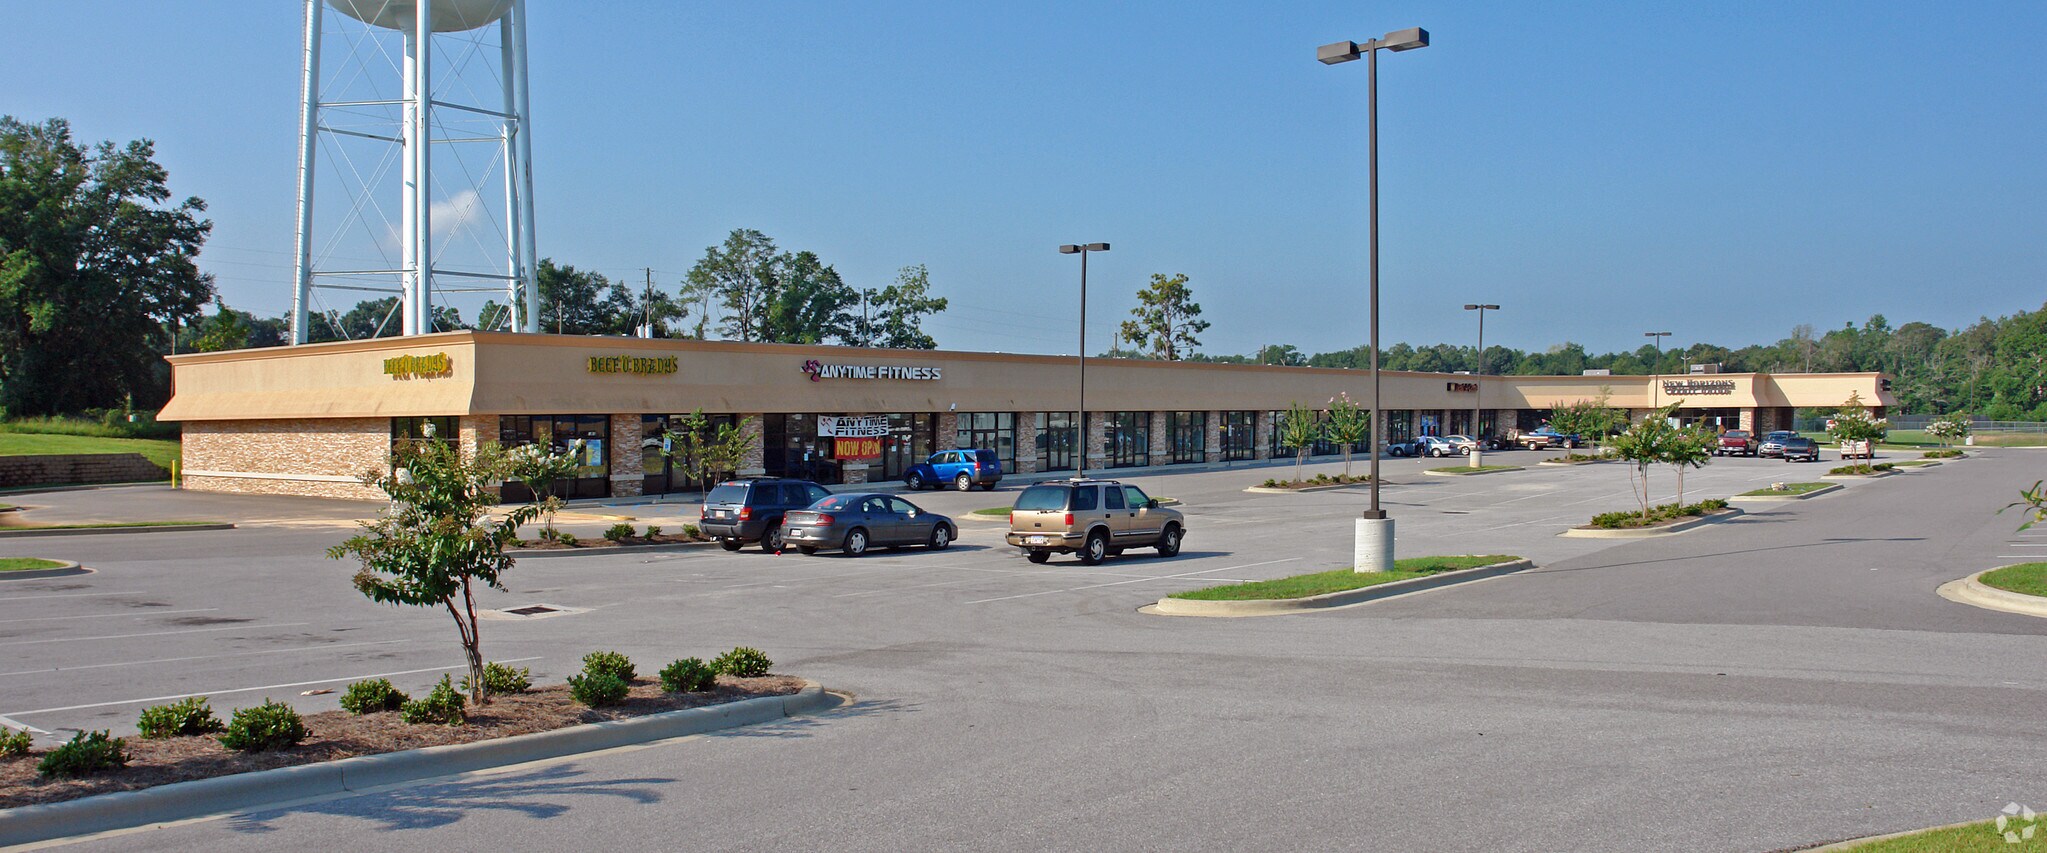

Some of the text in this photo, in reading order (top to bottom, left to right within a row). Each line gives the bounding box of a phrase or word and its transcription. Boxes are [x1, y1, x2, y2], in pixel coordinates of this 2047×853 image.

[588, 356, 619, 373] BEEF
[820, 364, 942, 380] ANYTIME FITNESS
[835, 415, 887, 426] ANYTIME
[835, 426, 887, 435] FITNESS
[836, 440, 860, 456] NOW
